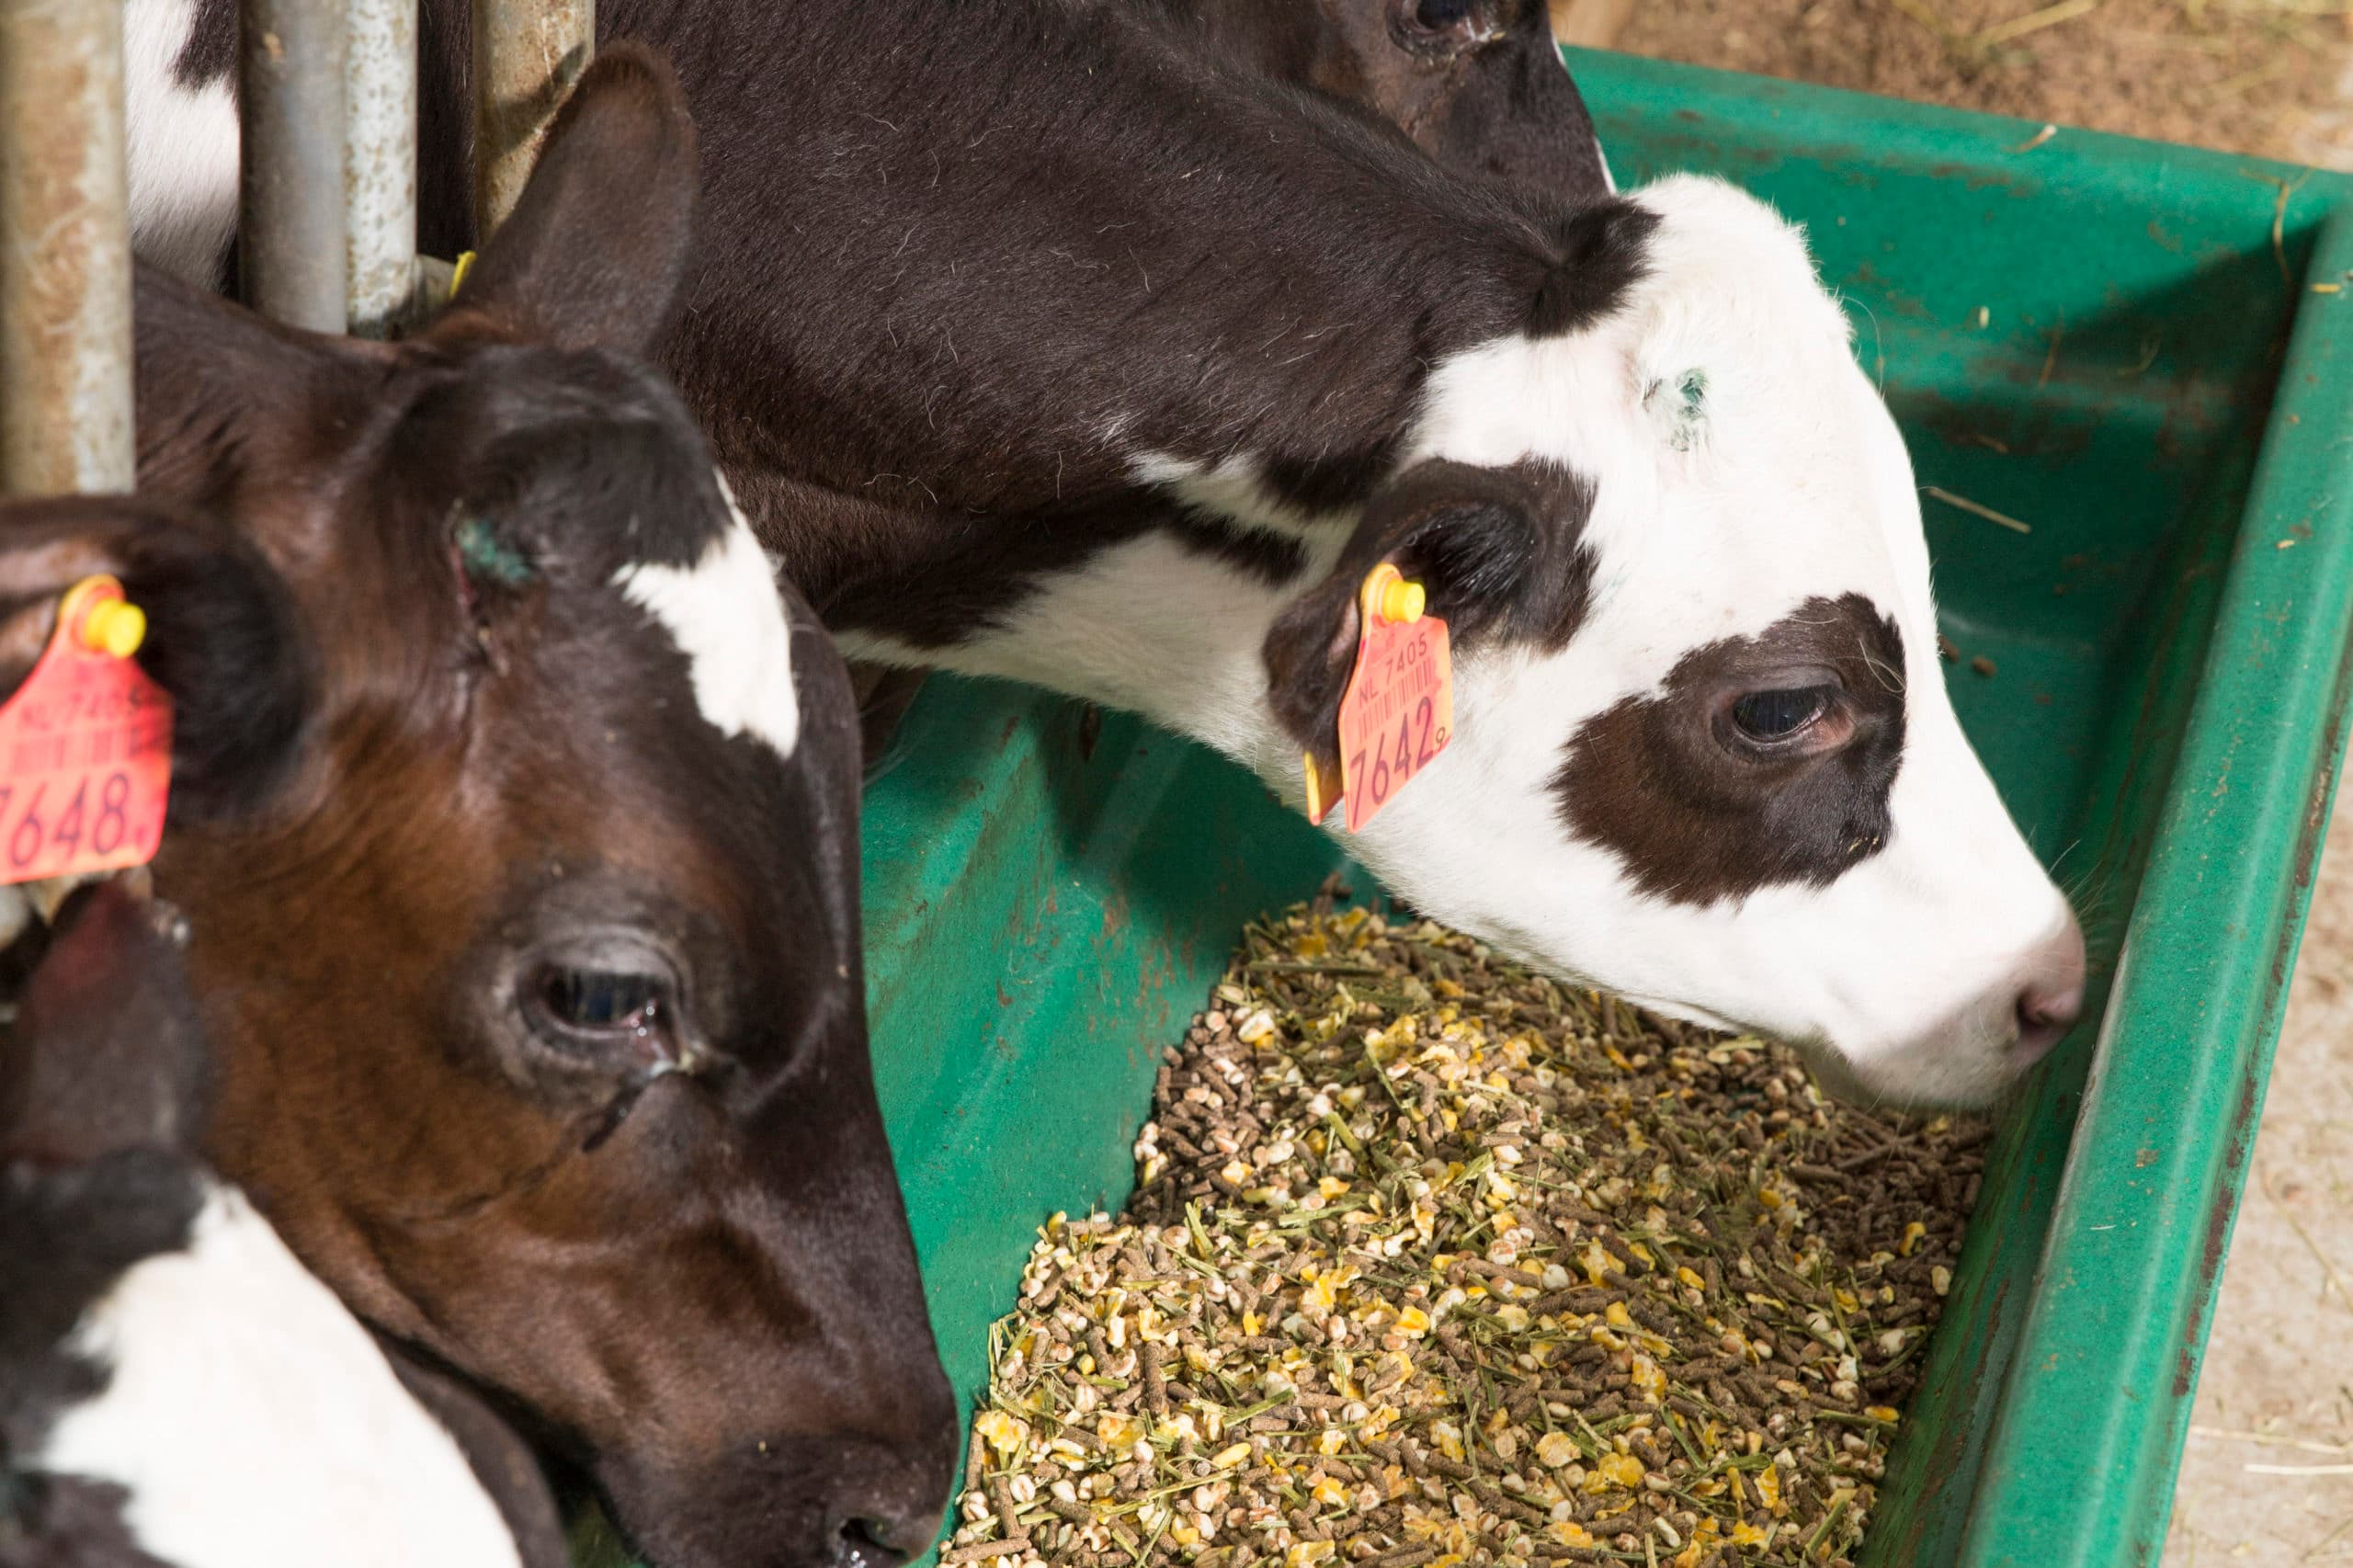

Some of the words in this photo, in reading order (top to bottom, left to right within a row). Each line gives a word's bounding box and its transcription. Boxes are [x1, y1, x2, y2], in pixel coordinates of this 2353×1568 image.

[1359, 676, 1379, 709] NL
[1386, 632, 1427, 685] 7405
[1349, 696, 1433, 826] 7642
